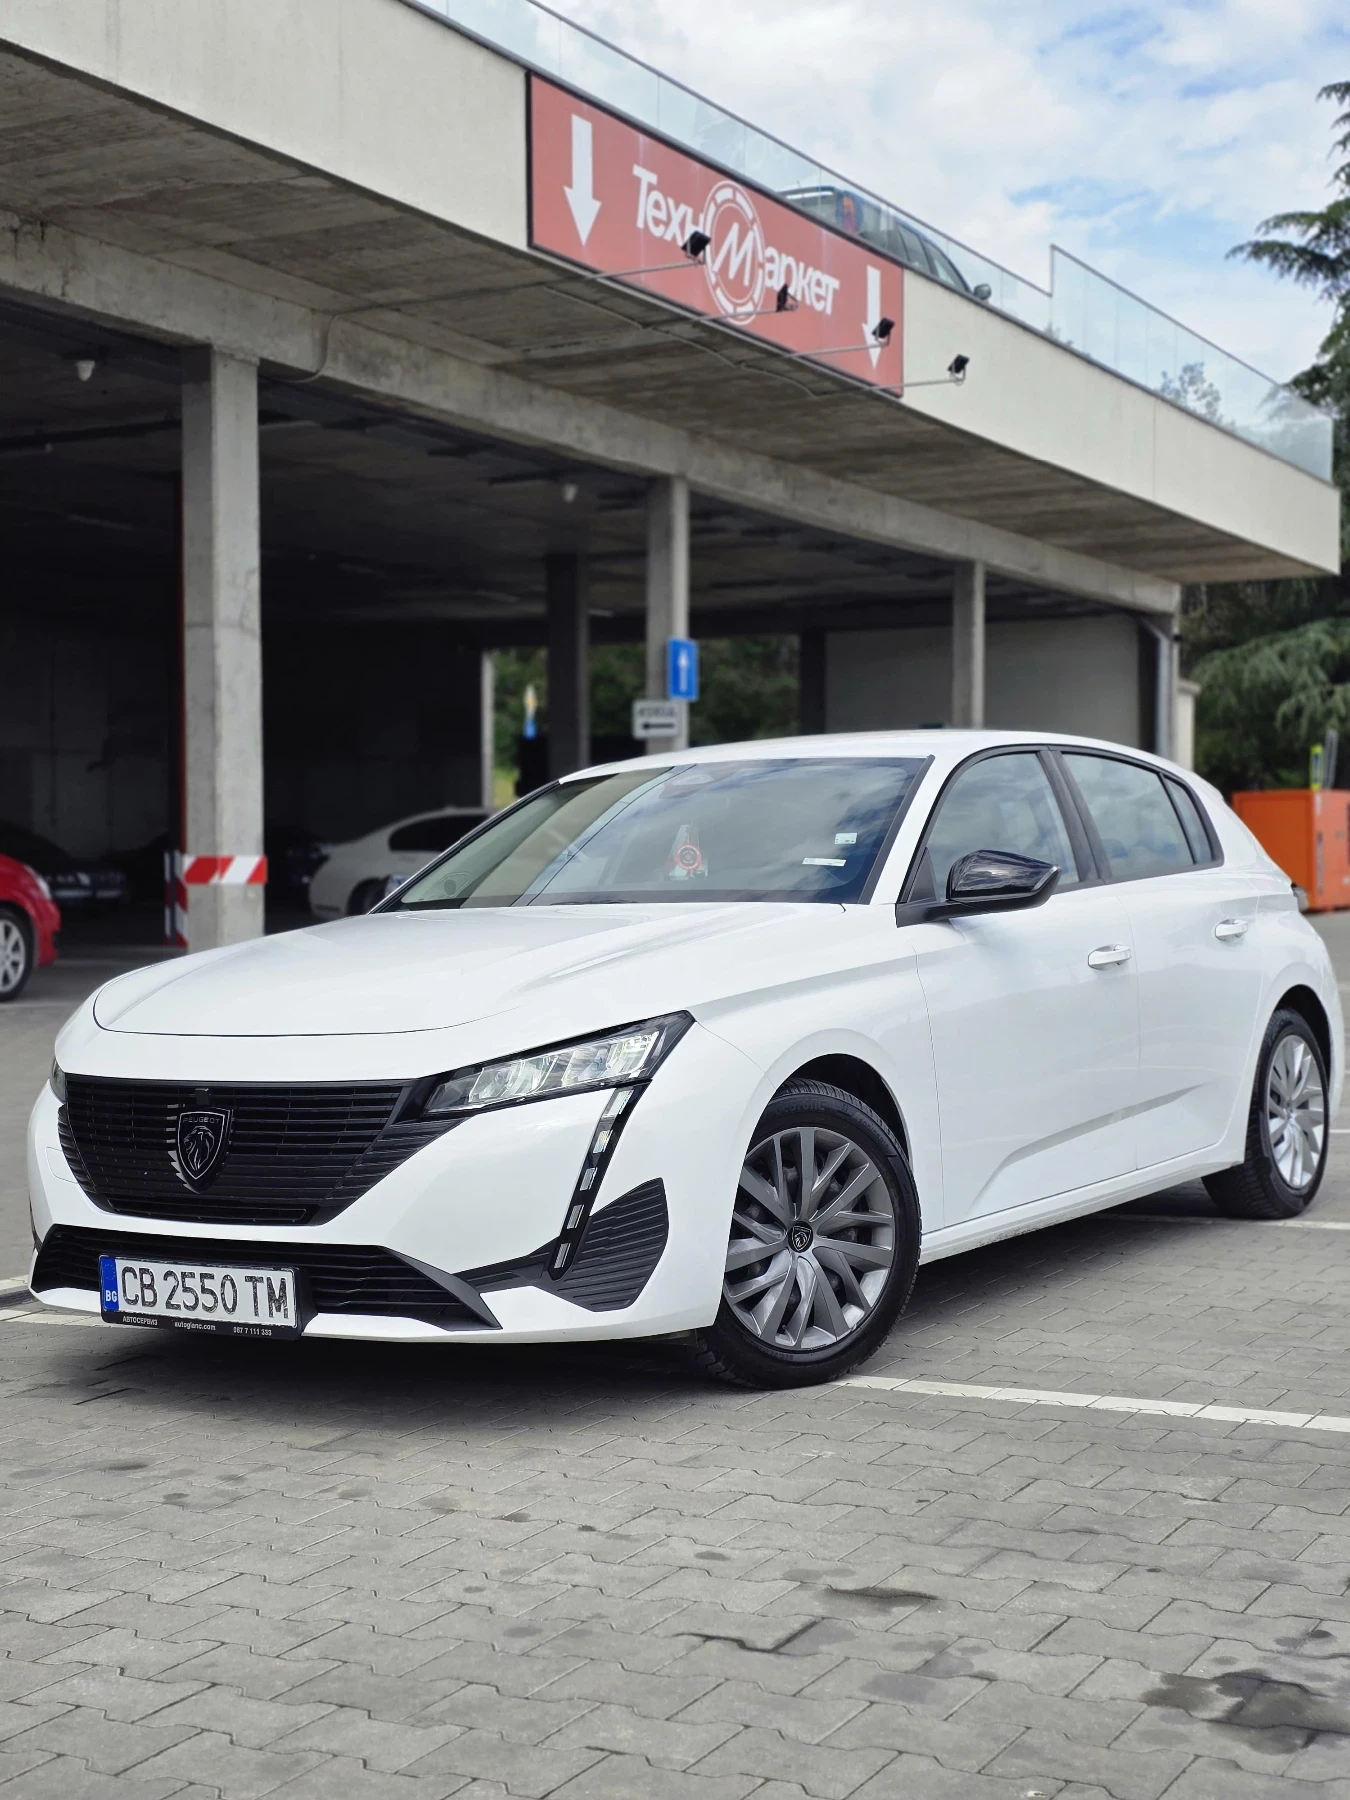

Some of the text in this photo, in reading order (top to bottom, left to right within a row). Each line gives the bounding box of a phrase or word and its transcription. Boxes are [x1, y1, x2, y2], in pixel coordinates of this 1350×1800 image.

[182, 1116, 220, 1124] PEUGEOT
[105, 1289, 118, 1302] BG
[121, 1266, 289, 1319] CB 2550 TM
[122, 1315, 158, 1326] АВТОСЕРВИЗ
